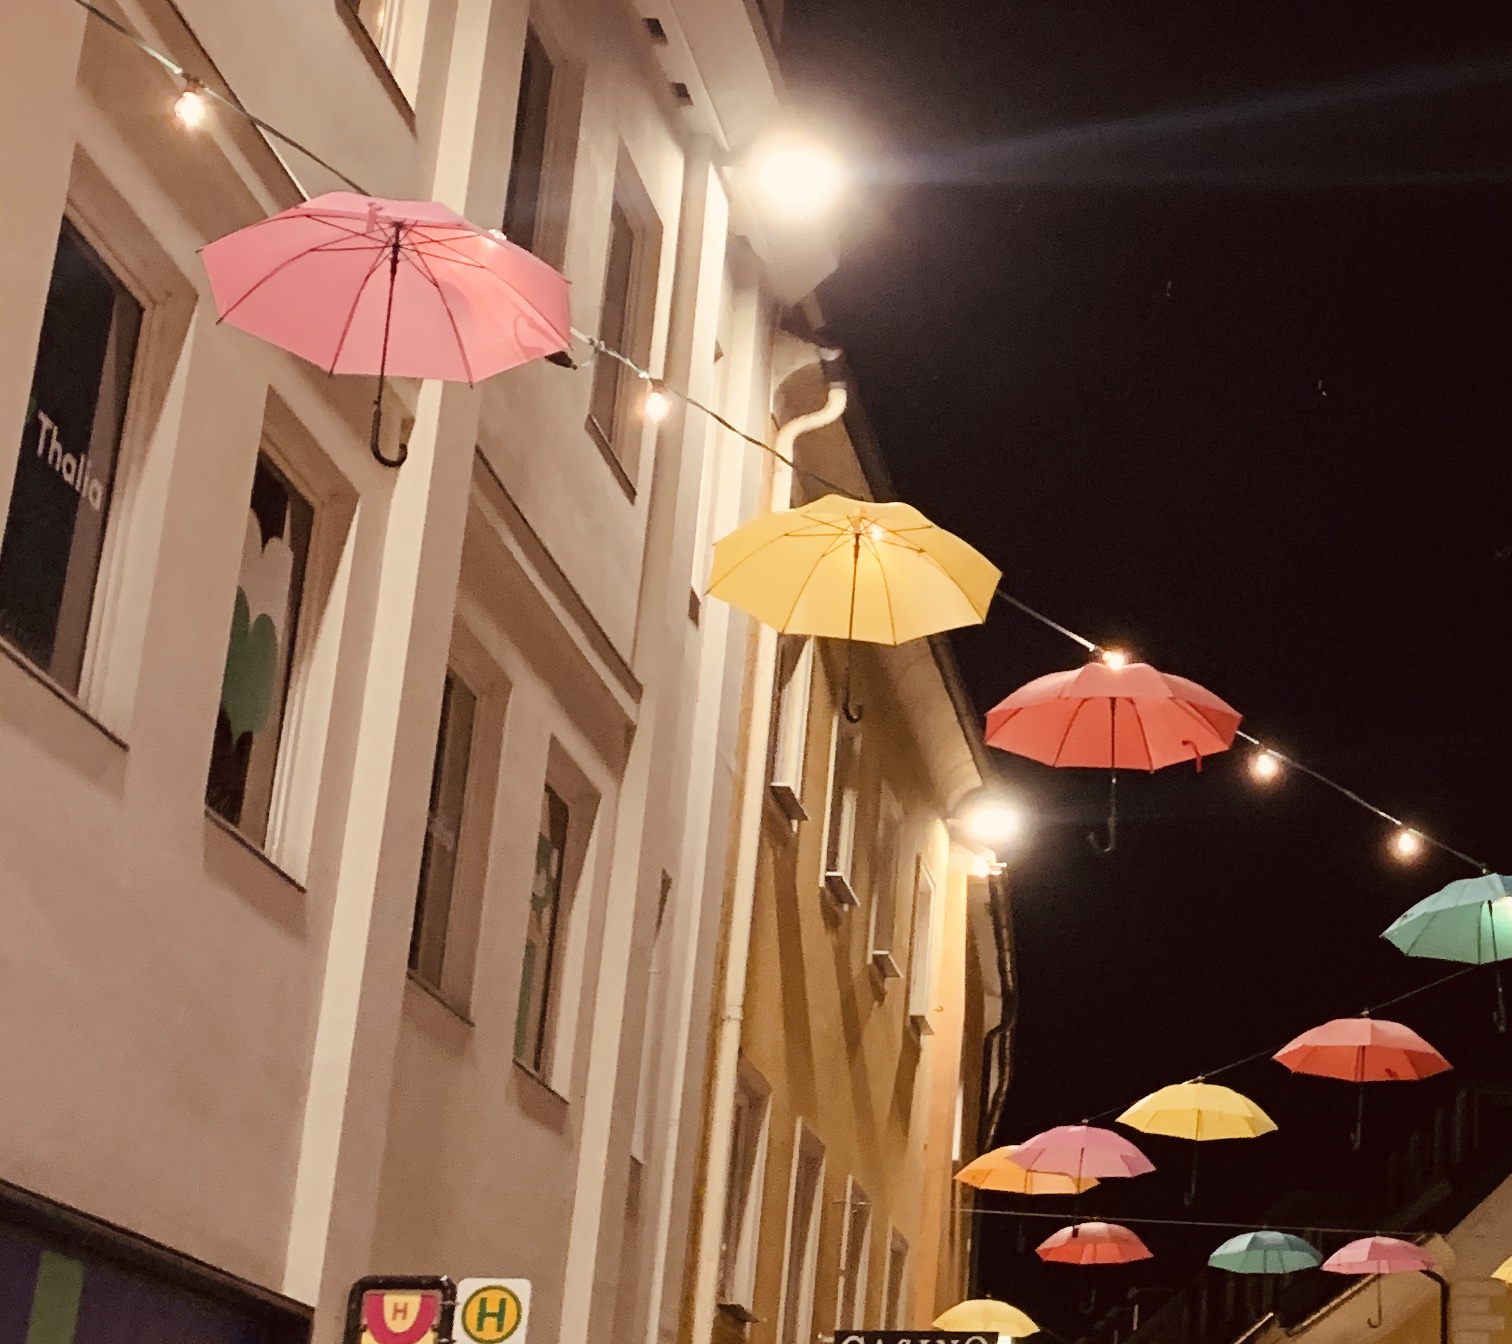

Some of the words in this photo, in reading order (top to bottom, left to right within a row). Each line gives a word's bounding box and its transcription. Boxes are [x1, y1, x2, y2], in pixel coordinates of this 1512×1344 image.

[37, 409, 104, 510] Thalia
[391, 1301, 408, 1321] H
[475, 1297, 507, 1332] H
